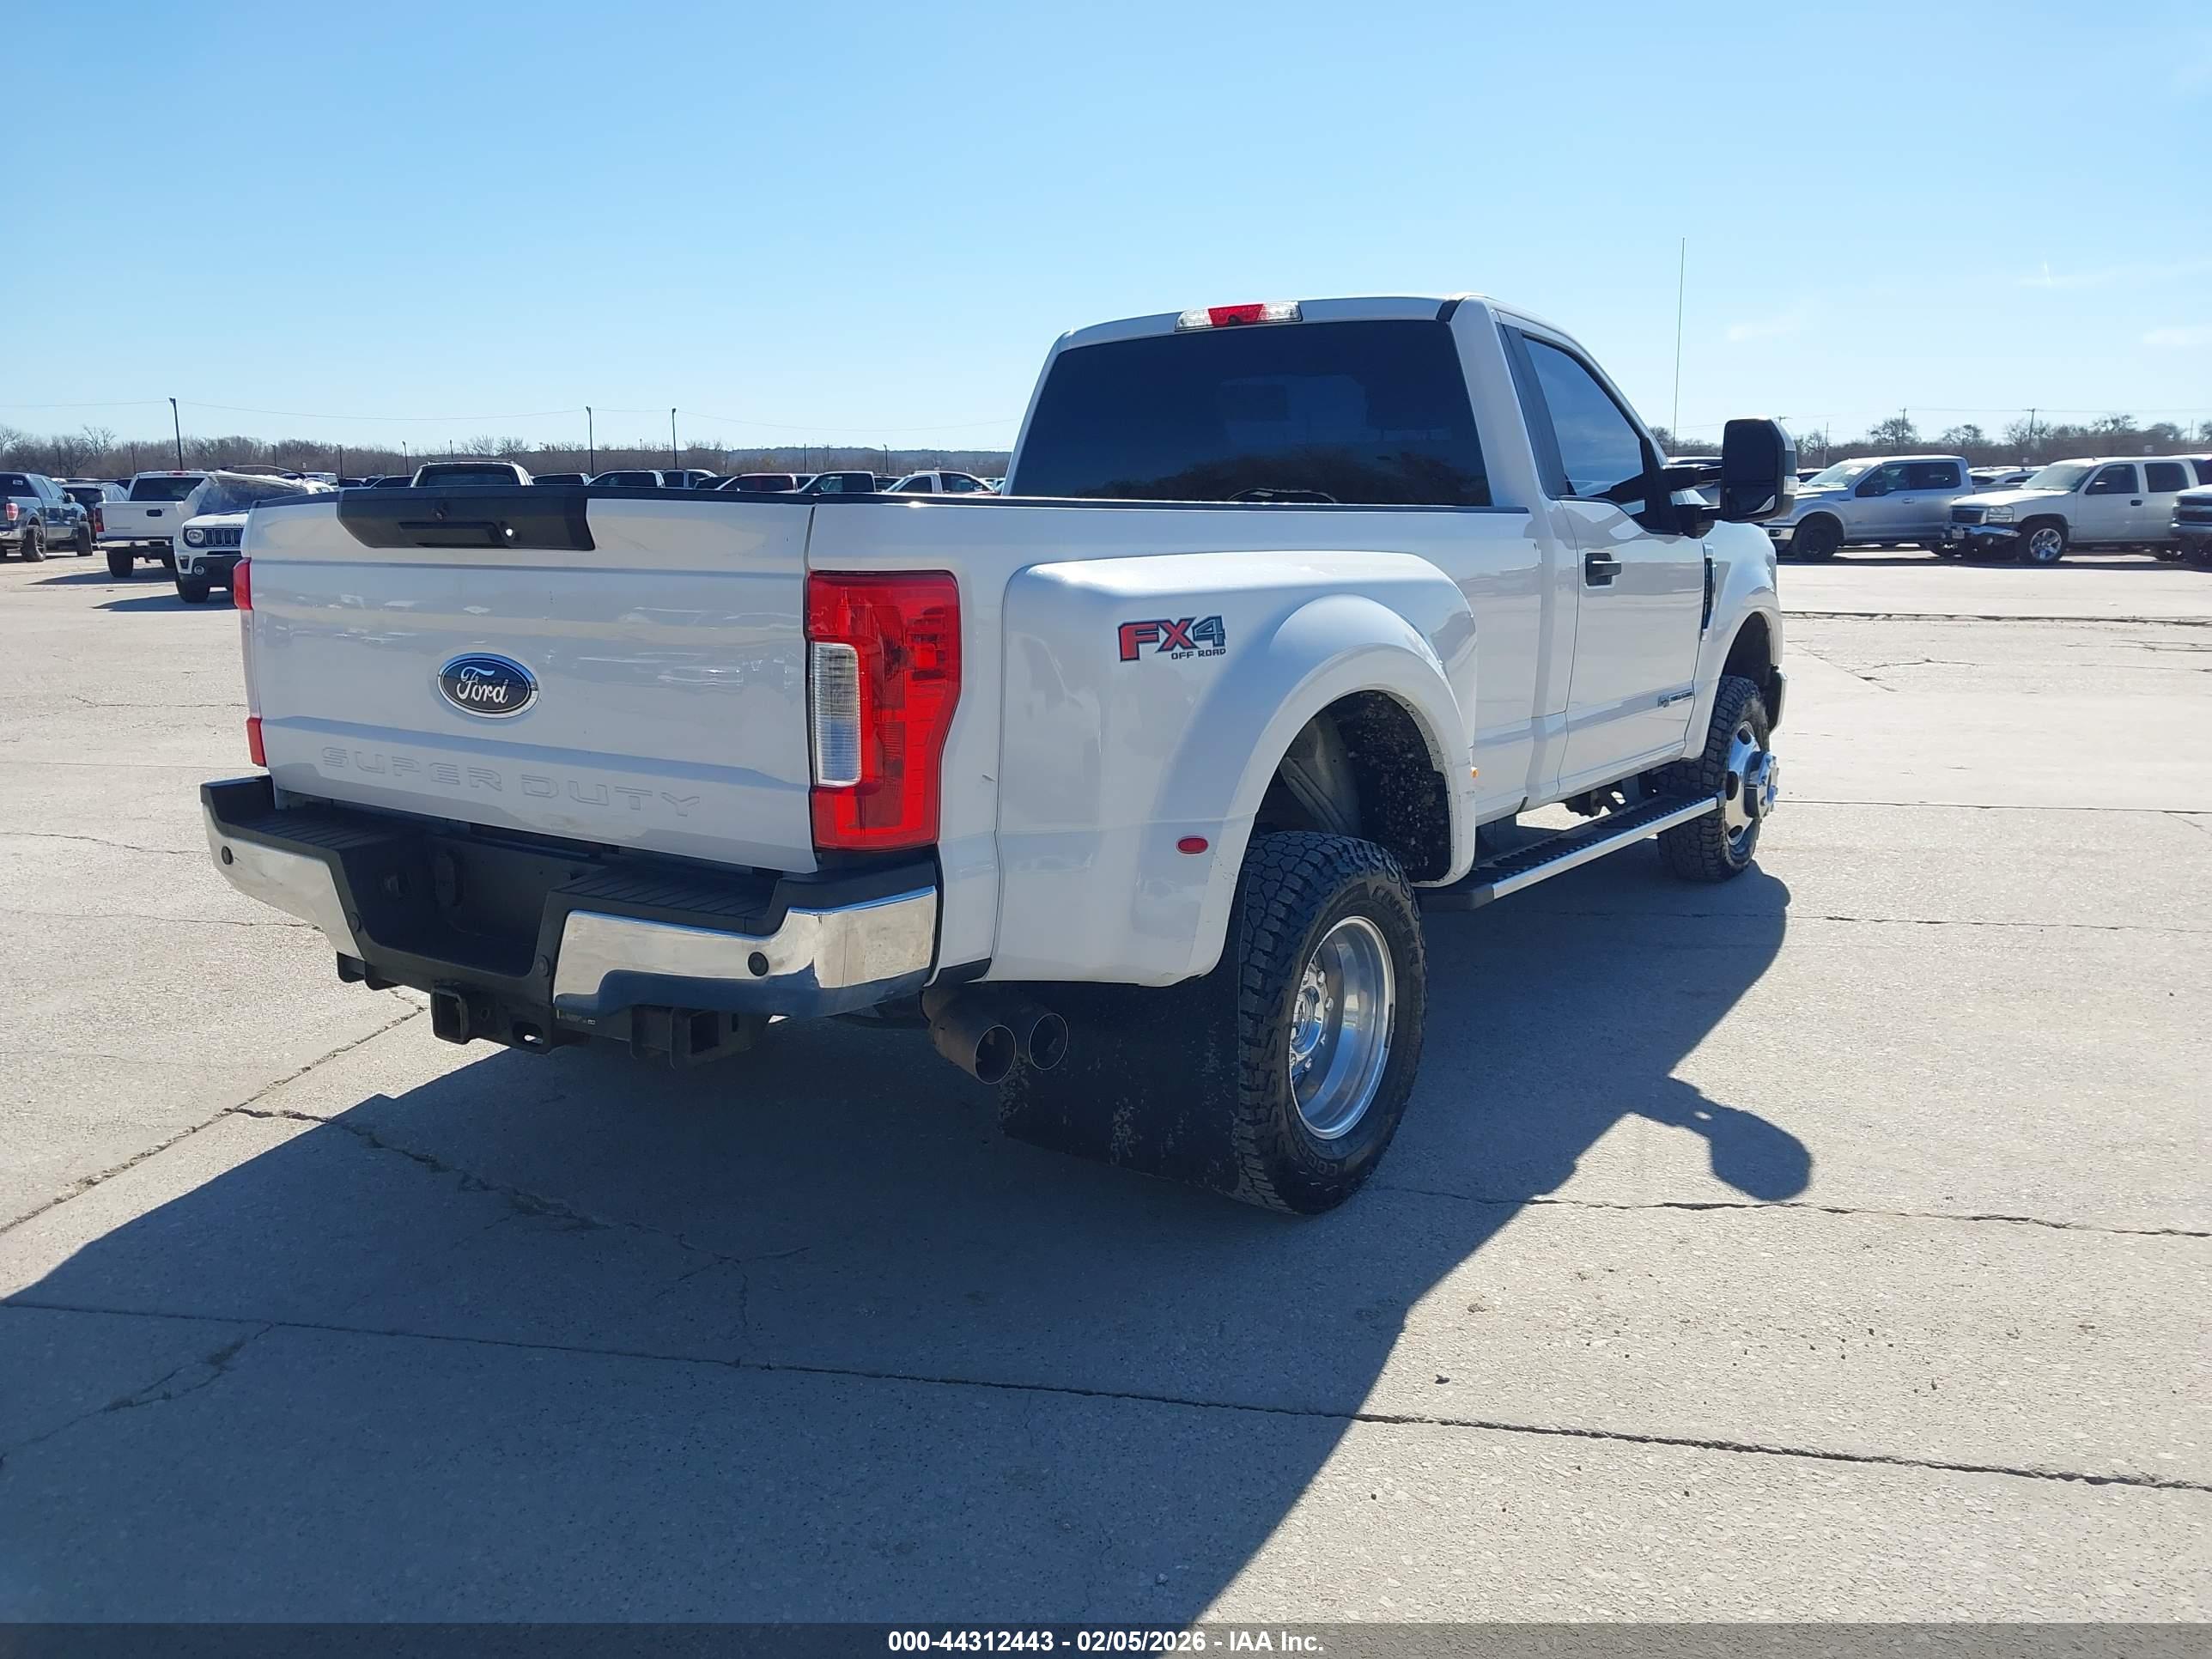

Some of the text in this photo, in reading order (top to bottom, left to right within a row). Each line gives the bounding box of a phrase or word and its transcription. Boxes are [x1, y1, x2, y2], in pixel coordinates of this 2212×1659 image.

[1118, 615, 1226, 663] FX4
[1170, 648, 1226, 660] OFF ROAD
[456, 665, 510, 705] Ford
[321, 746, 701, 817] SUPER DUTY
